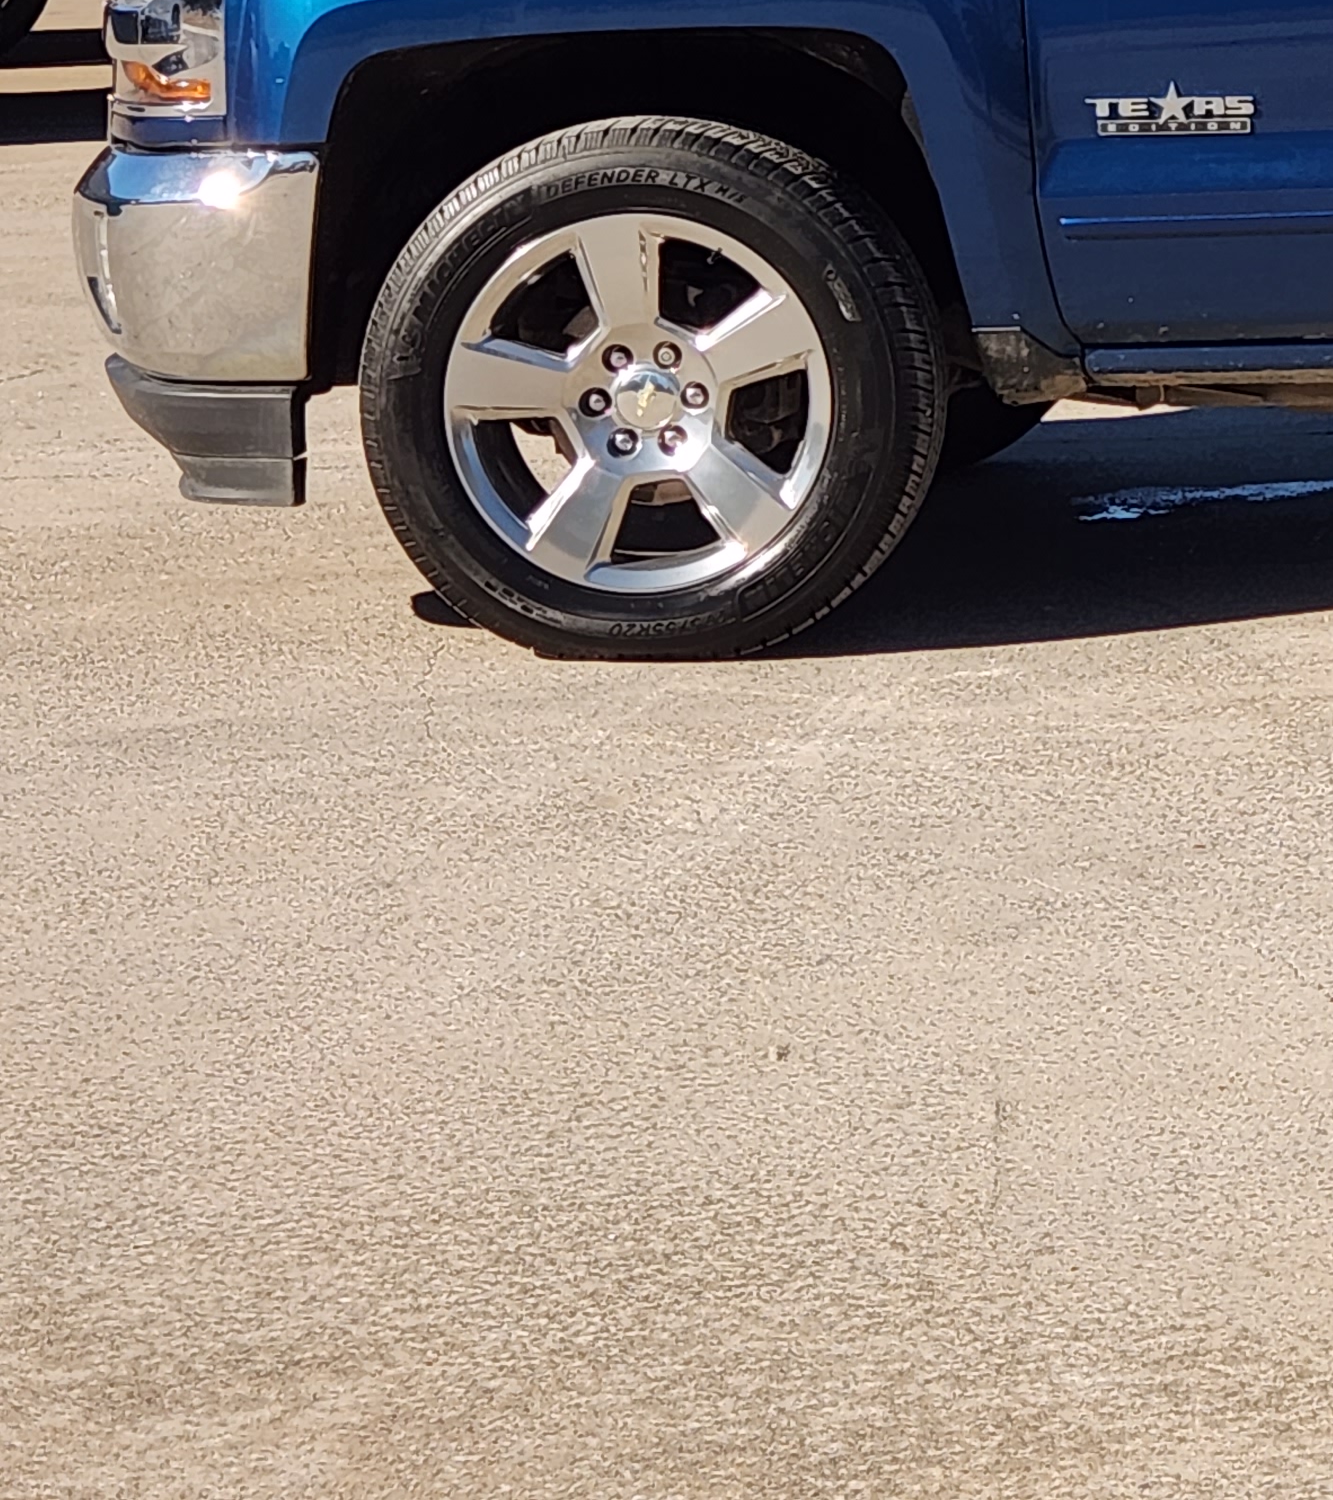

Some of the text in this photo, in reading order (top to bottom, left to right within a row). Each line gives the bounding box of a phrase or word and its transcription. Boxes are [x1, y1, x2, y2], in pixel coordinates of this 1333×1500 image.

[1084, 83, 1255, 121] TEXAS
[1106, 121, 1242, 133] EDITION
[546, 168, 660, 200] DEFENDER
[668, 171, 711, 194] LTX
